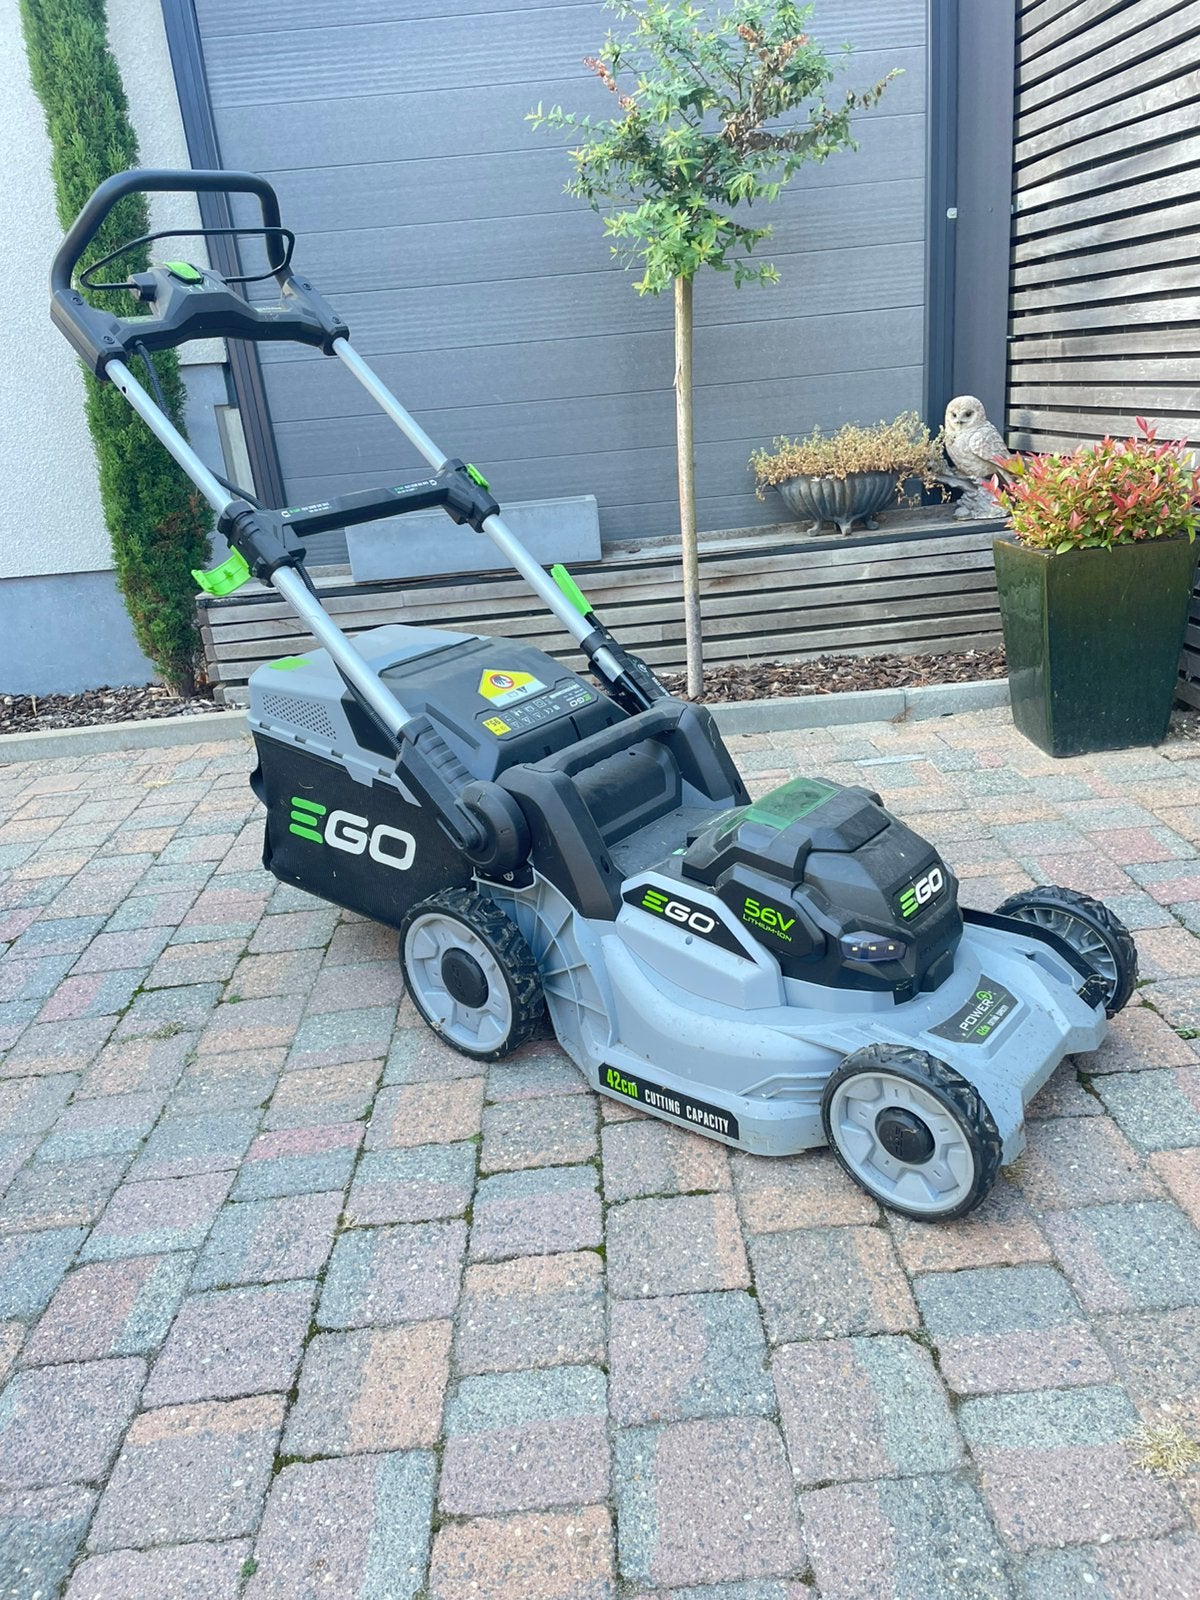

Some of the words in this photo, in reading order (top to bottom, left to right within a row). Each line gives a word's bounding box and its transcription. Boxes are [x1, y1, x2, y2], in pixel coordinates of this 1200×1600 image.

[289, 796, 416, 871] EGO
[642, 889, 716, 934] EGO
[744, 897, 796, 932] 56V
[900, 867, 943, 917] EGO
[742, 913, 793, 943] LITHIUM-ION
[606, 1068, 639, 1098] 42cm
[644, 1089, 681, 1115] CUTTING
[686, 1105, 729, 1134] CAPACITY
